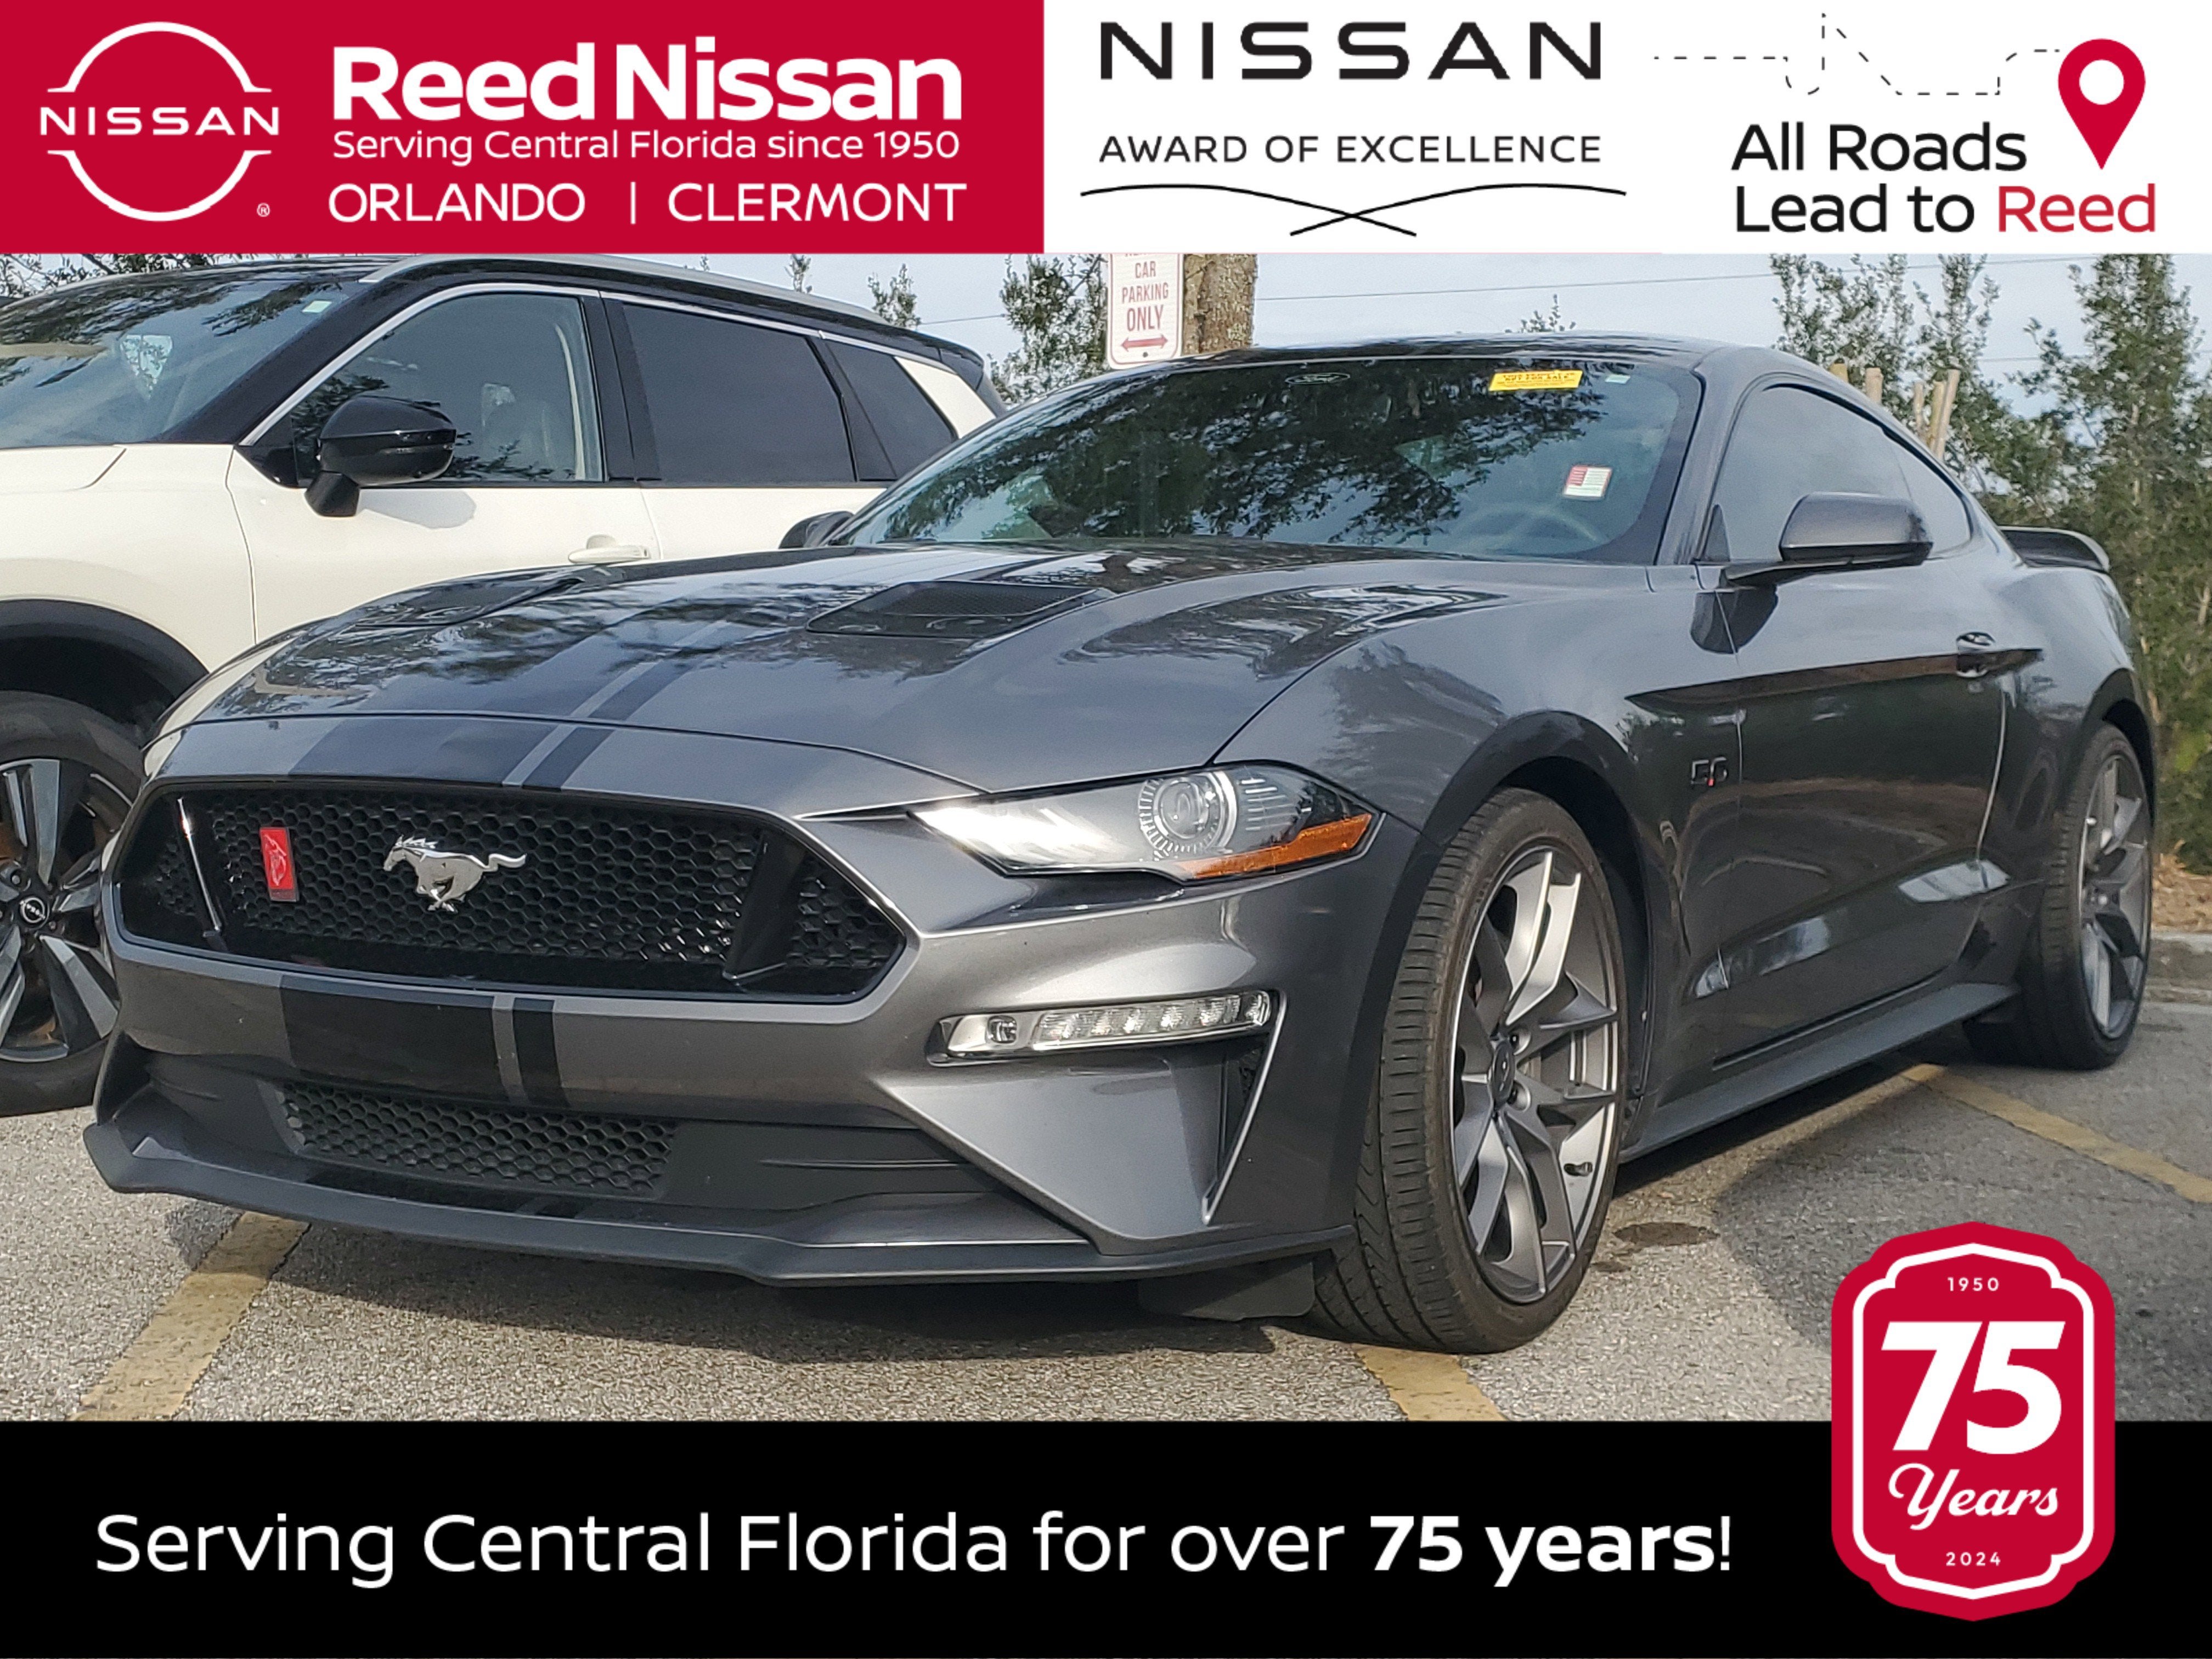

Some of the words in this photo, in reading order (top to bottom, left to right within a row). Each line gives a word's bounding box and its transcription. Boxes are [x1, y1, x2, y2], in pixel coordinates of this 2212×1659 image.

[1135, 261, 1156, 278] CAR
[1122, 282, 1169, 303] PARKING
[1127, 305, 1164, 331] ONLY
